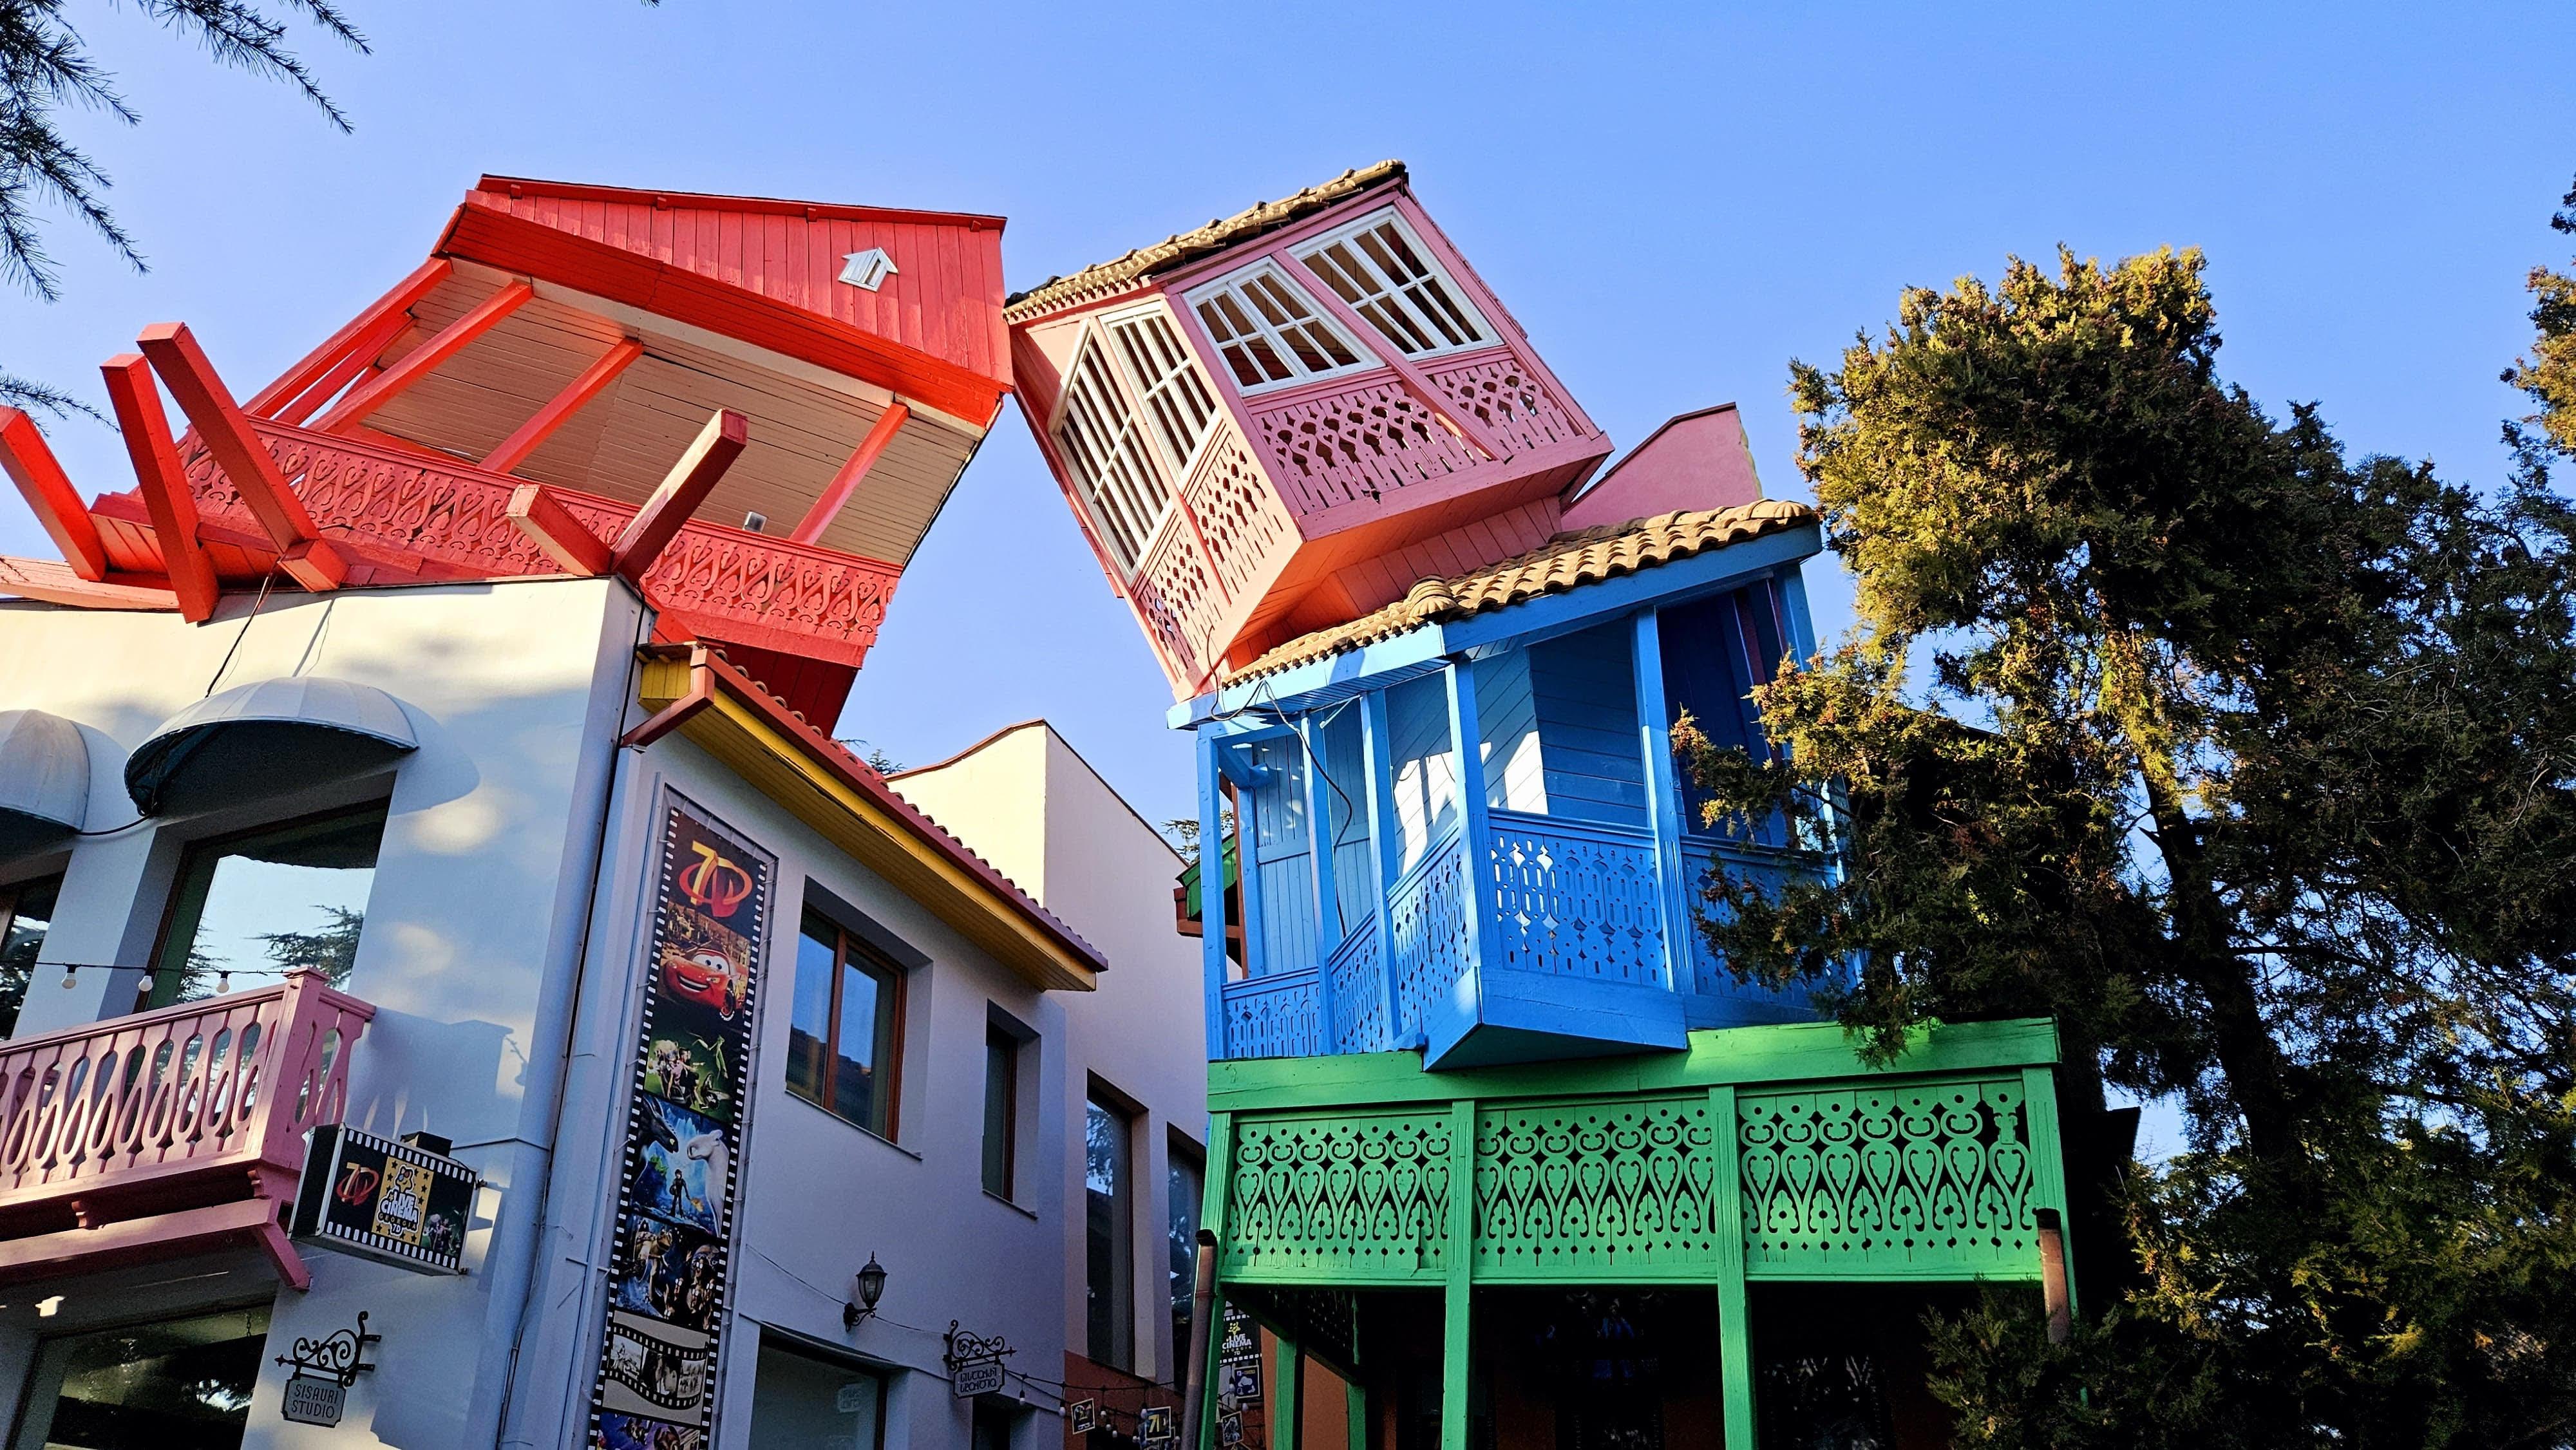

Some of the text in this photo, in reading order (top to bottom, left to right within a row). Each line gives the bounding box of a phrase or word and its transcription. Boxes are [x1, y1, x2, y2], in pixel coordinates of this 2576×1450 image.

[393, 1191, 415, 1208] LIVE
[381, 1200, 417, 1223] CINEMA
[379, 1213, 416, 1229] GEORGIA
[392, 1223, 401, 1233] 7D
[1222, 1339, 1252, 1350] CINEMA
[1228, 1333, 1246, 1344] LIVE
[294, 1384, 339, 1404] SISAURI
[292, 1400, 335, 1418] STUDIO
